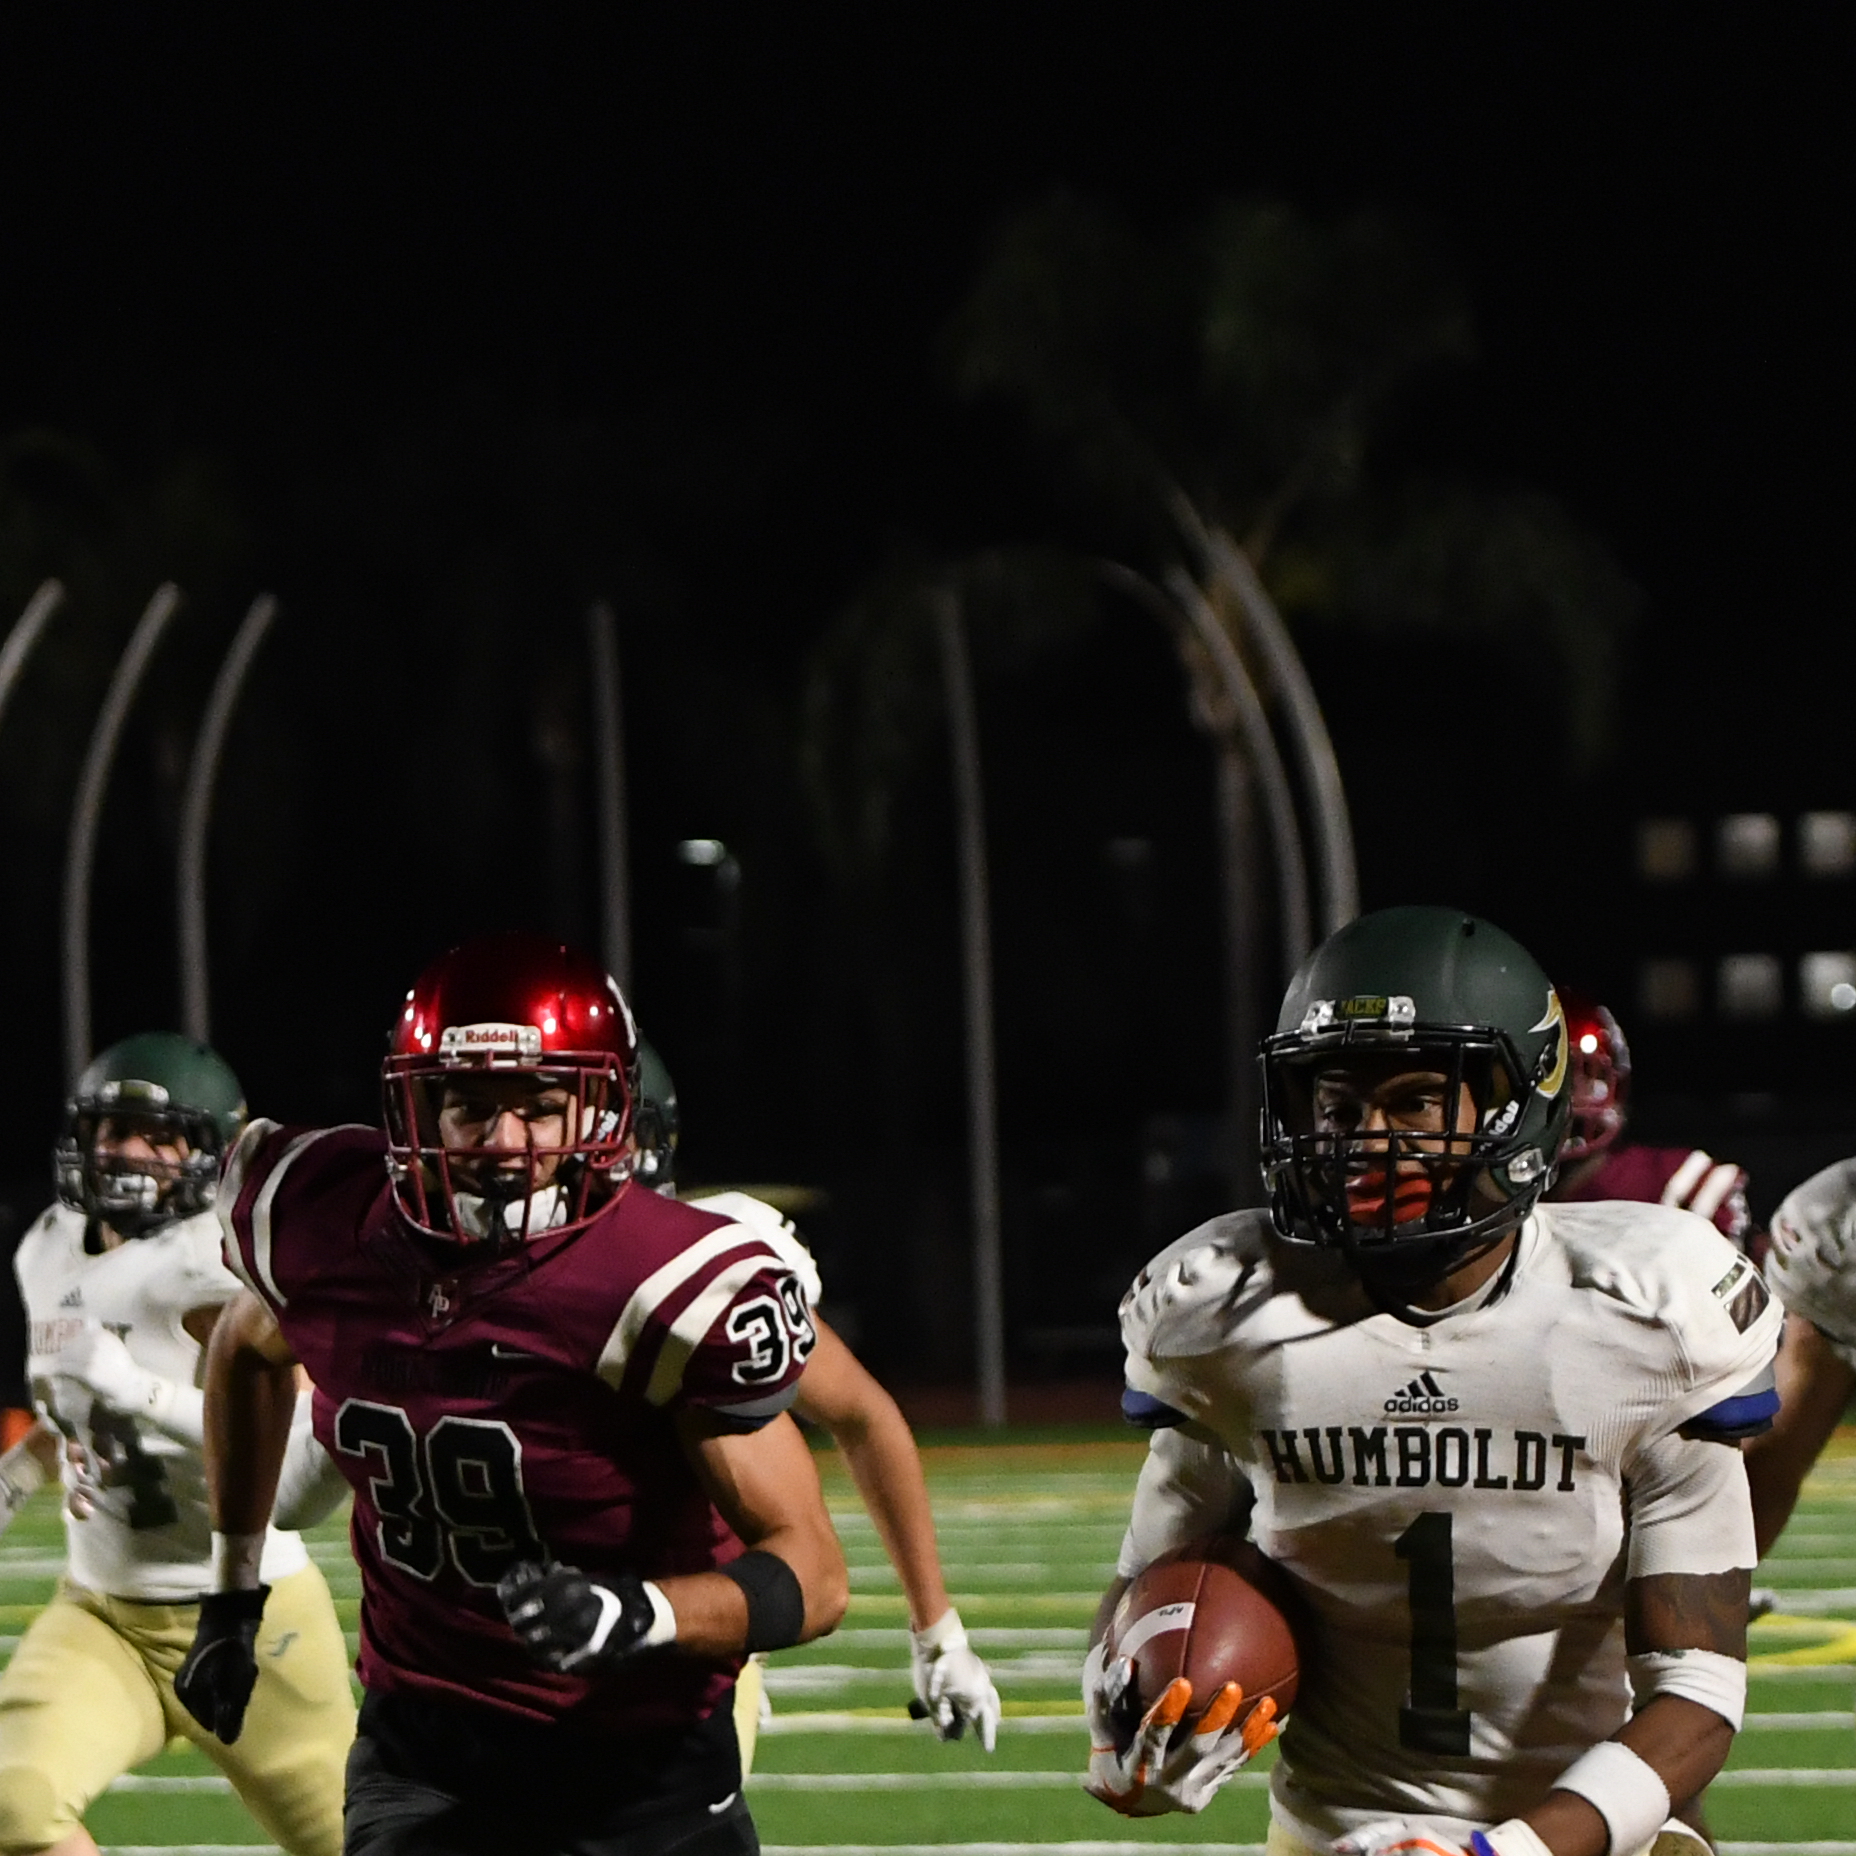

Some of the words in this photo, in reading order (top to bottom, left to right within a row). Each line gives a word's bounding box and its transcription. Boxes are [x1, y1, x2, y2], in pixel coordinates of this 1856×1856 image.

[465, 1029, 519, 1043] Riddell
[725, 1273, 818, 1385] 39
[1383, 1397, 1459, 1413] adidas
[335, 1398, 550, 1588] 39
[1262, 1426, 1587, 1492] HUMBOLDT
[1395, 1511, 1471, 1757] 1
